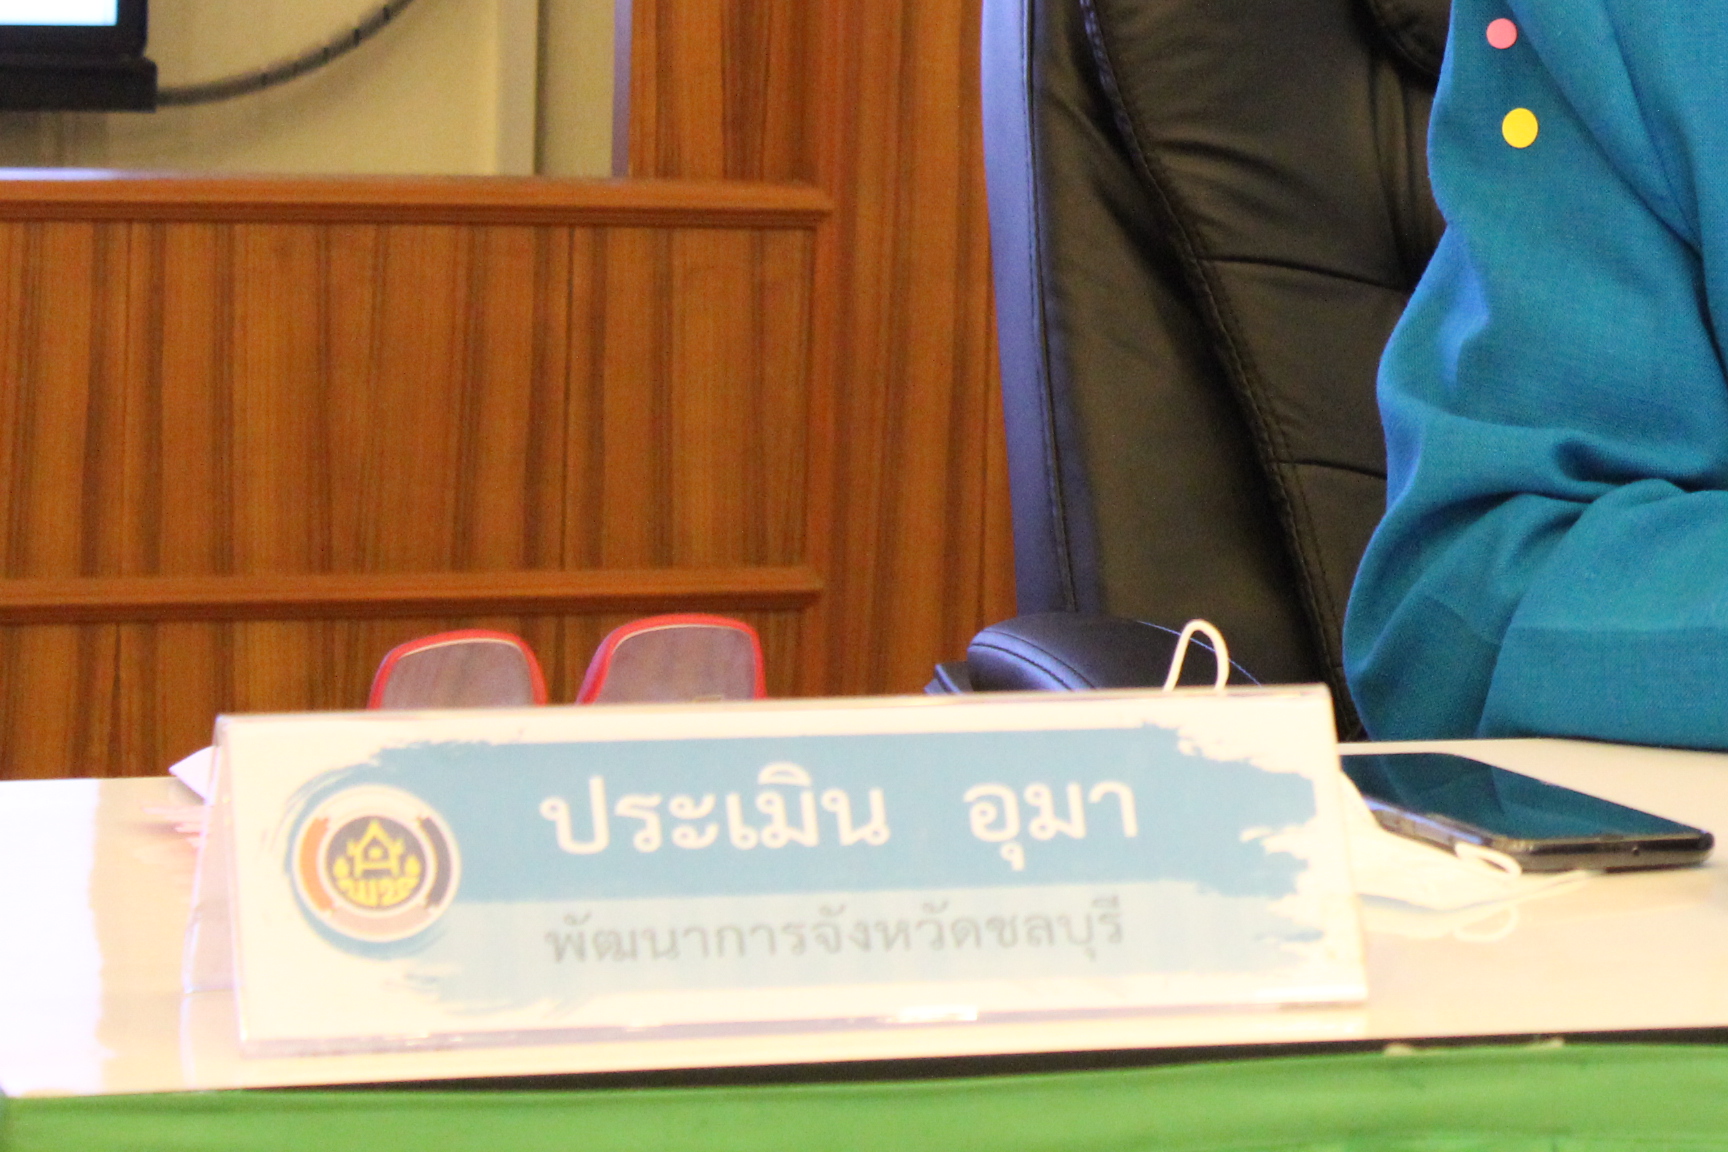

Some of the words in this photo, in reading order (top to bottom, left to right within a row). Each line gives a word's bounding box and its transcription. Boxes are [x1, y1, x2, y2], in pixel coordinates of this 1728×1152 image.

[539, 760, 891, 855] ประเมิน
[962, 779, 1138, 872] อุมา
[543, 894, 1125, 963] พัฒนาการจังหวัดชลบุรี
